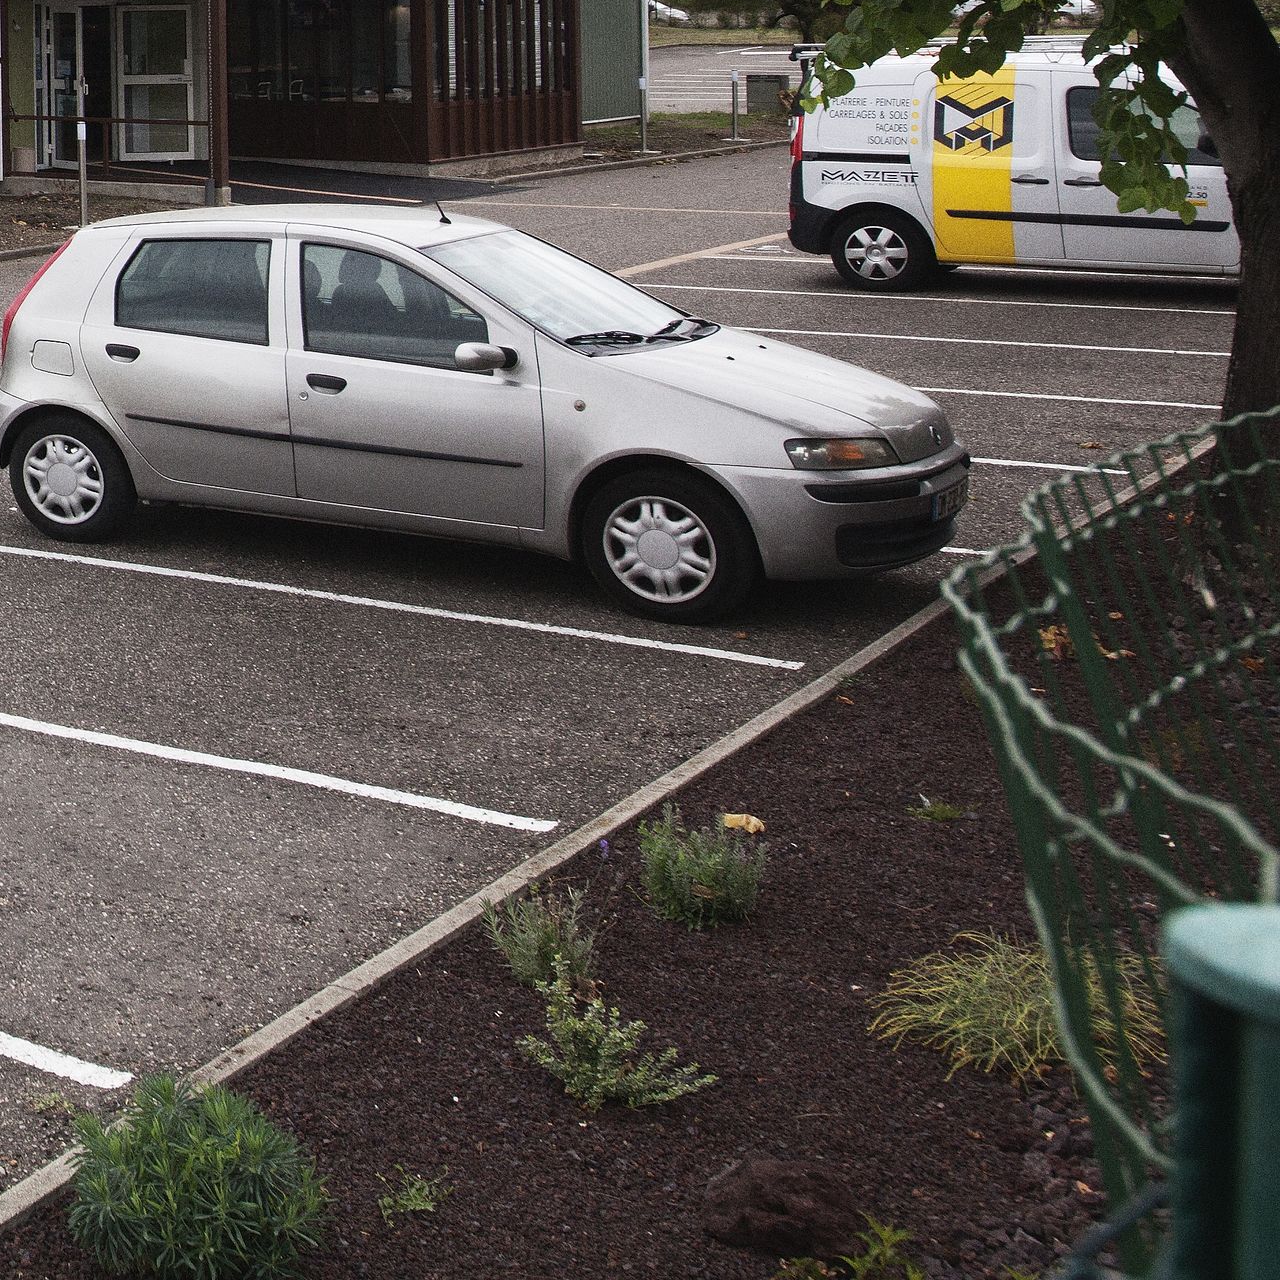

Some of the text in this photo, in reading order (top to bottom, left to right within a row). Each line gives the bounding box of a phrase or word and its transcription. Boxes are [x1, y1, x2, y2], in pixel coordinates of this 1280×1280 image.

[875, 97, 911, 107] PEINTURE
[829, 109, 877, 119] CARRELAGES
[889, 110, 909, 120] SOLS
[875, 123, 908, 134] FAÇADES
[867, 135, 908, 146] ISOLATION
[821, 169, 919, 182] MAZET
